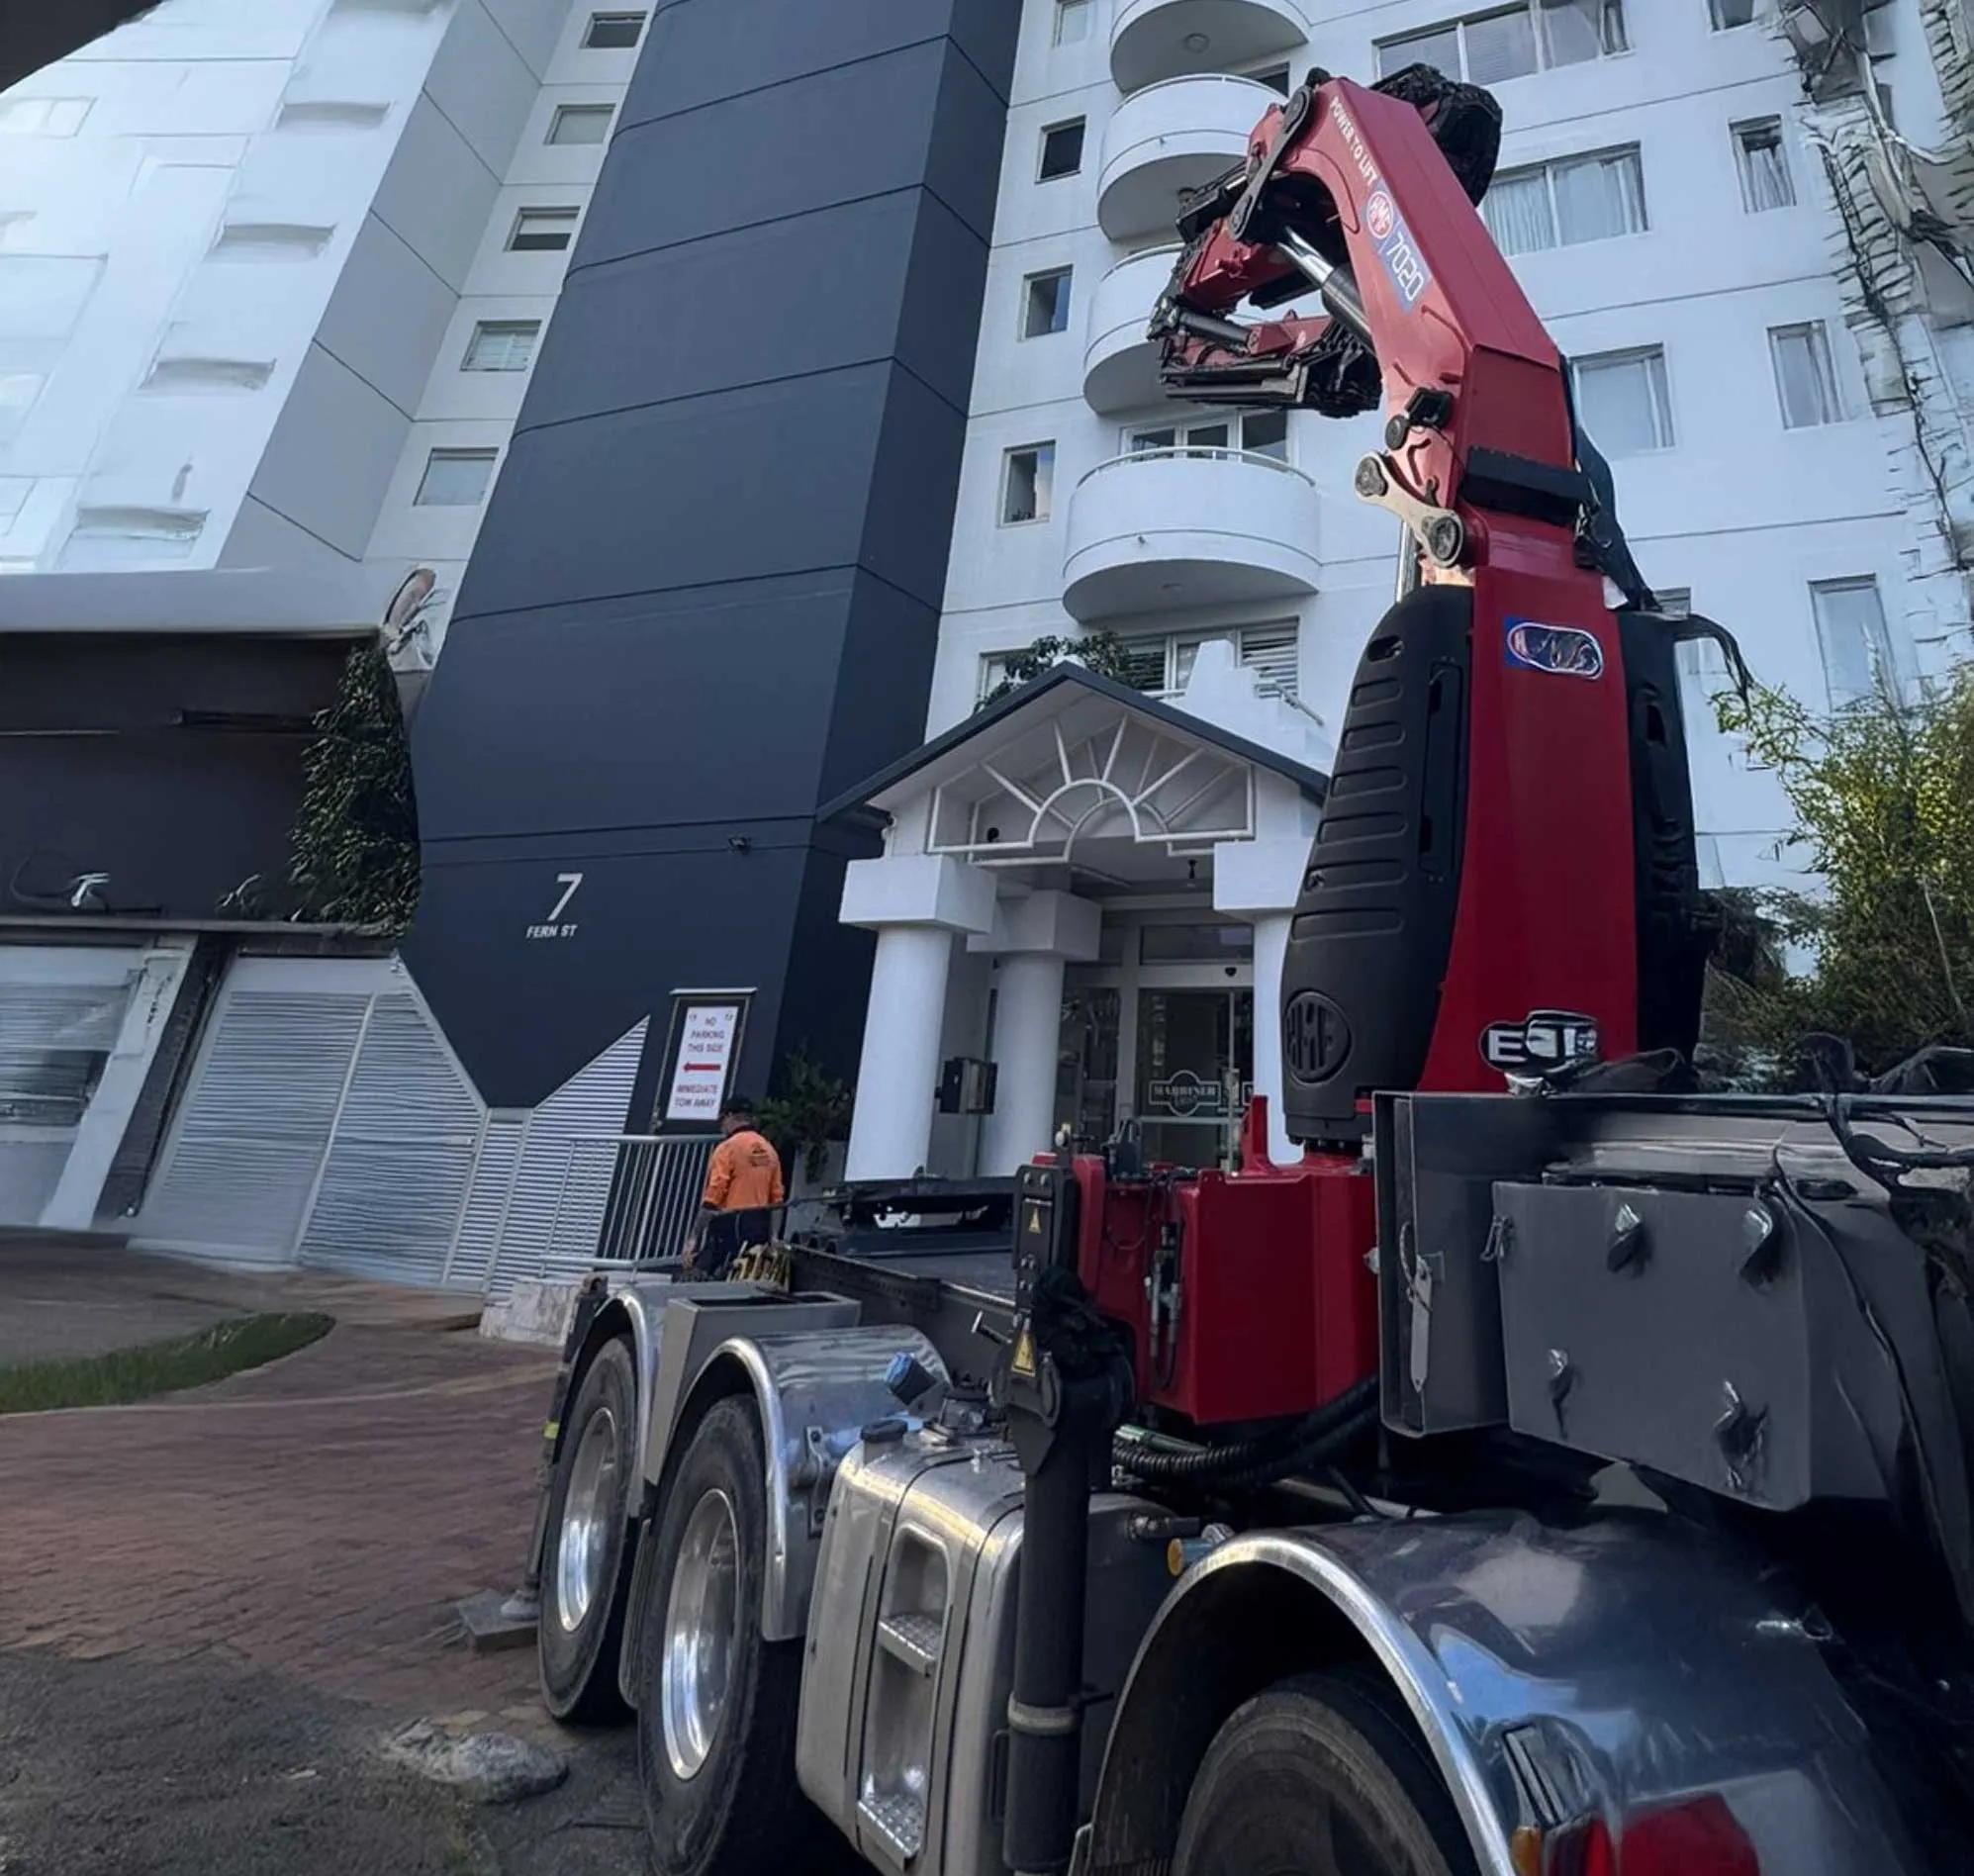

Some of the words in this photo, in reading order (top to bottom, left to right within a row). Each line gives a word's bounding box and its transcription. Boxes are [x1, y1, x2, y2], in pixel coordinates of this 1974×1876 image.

[1330, 95, 1355, 143] POWER
[1350, 135, 1363, 159] TO
[1359, 153, 1377, 186] LIFT
[1387, 231, 1425, 302] 7020
[546, 873, 584, 921] 7
[525, 925, 559, 939] FERN
[561, 924, 579, 938] ST
[691, 1030, 725, 1040] PARKING
